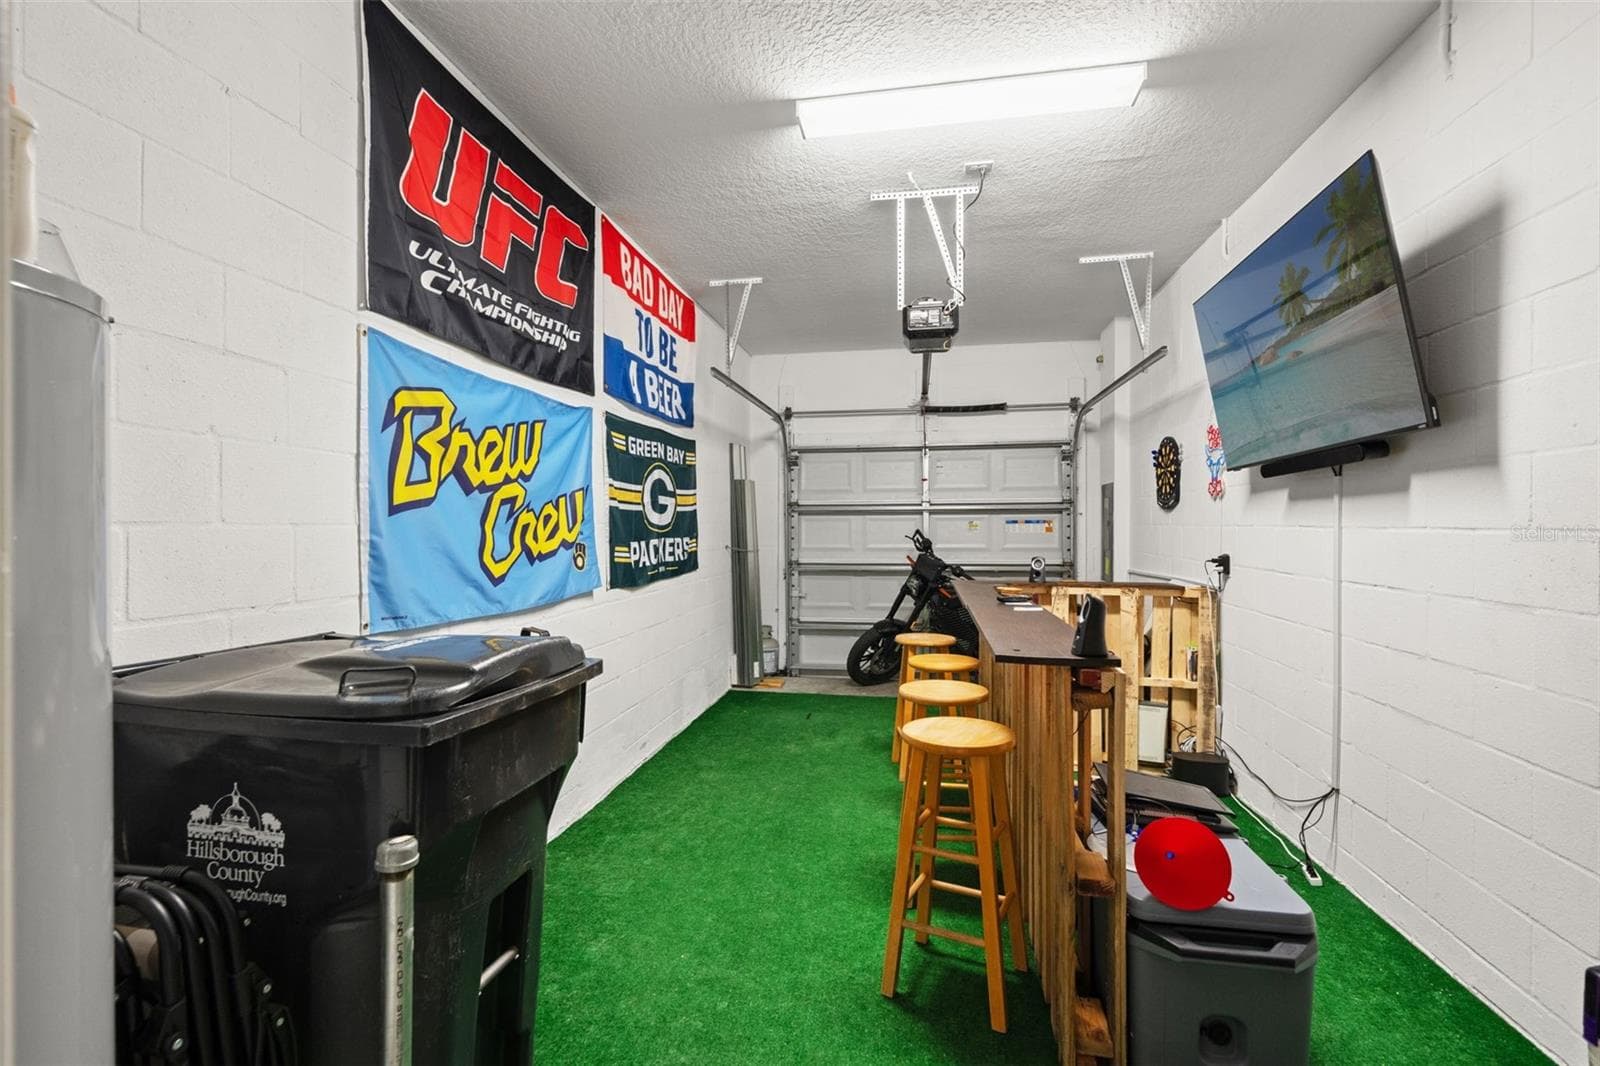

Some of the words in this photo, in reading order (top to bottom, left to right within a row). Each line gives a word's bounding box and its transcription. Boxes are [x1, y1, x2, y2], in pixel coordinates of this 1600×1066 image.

[400, 87, 589, 310] UFC
[409, 240, 513, 309] ULTMATE
[619, 241, 654, 307] BAD
[658, 277, 685, 332] DAY
[420, 270, 568, 352] CHAMPIONSHIP
[635, 308, 654, 359] TO
[659, 326, 678, 373] BE
[644, 368, 686, 420] BEER
[381, 386, 547, 517] Brew
[628, 435, 665, 460] GREEN
[666, 449, 685, 465] BAY
[643, 469, 677, 526] G
[630, 536, 690, 568] PACKERS
[186, 840, 285, 871] Hillsborough
[207, 861, 265, 889] County
